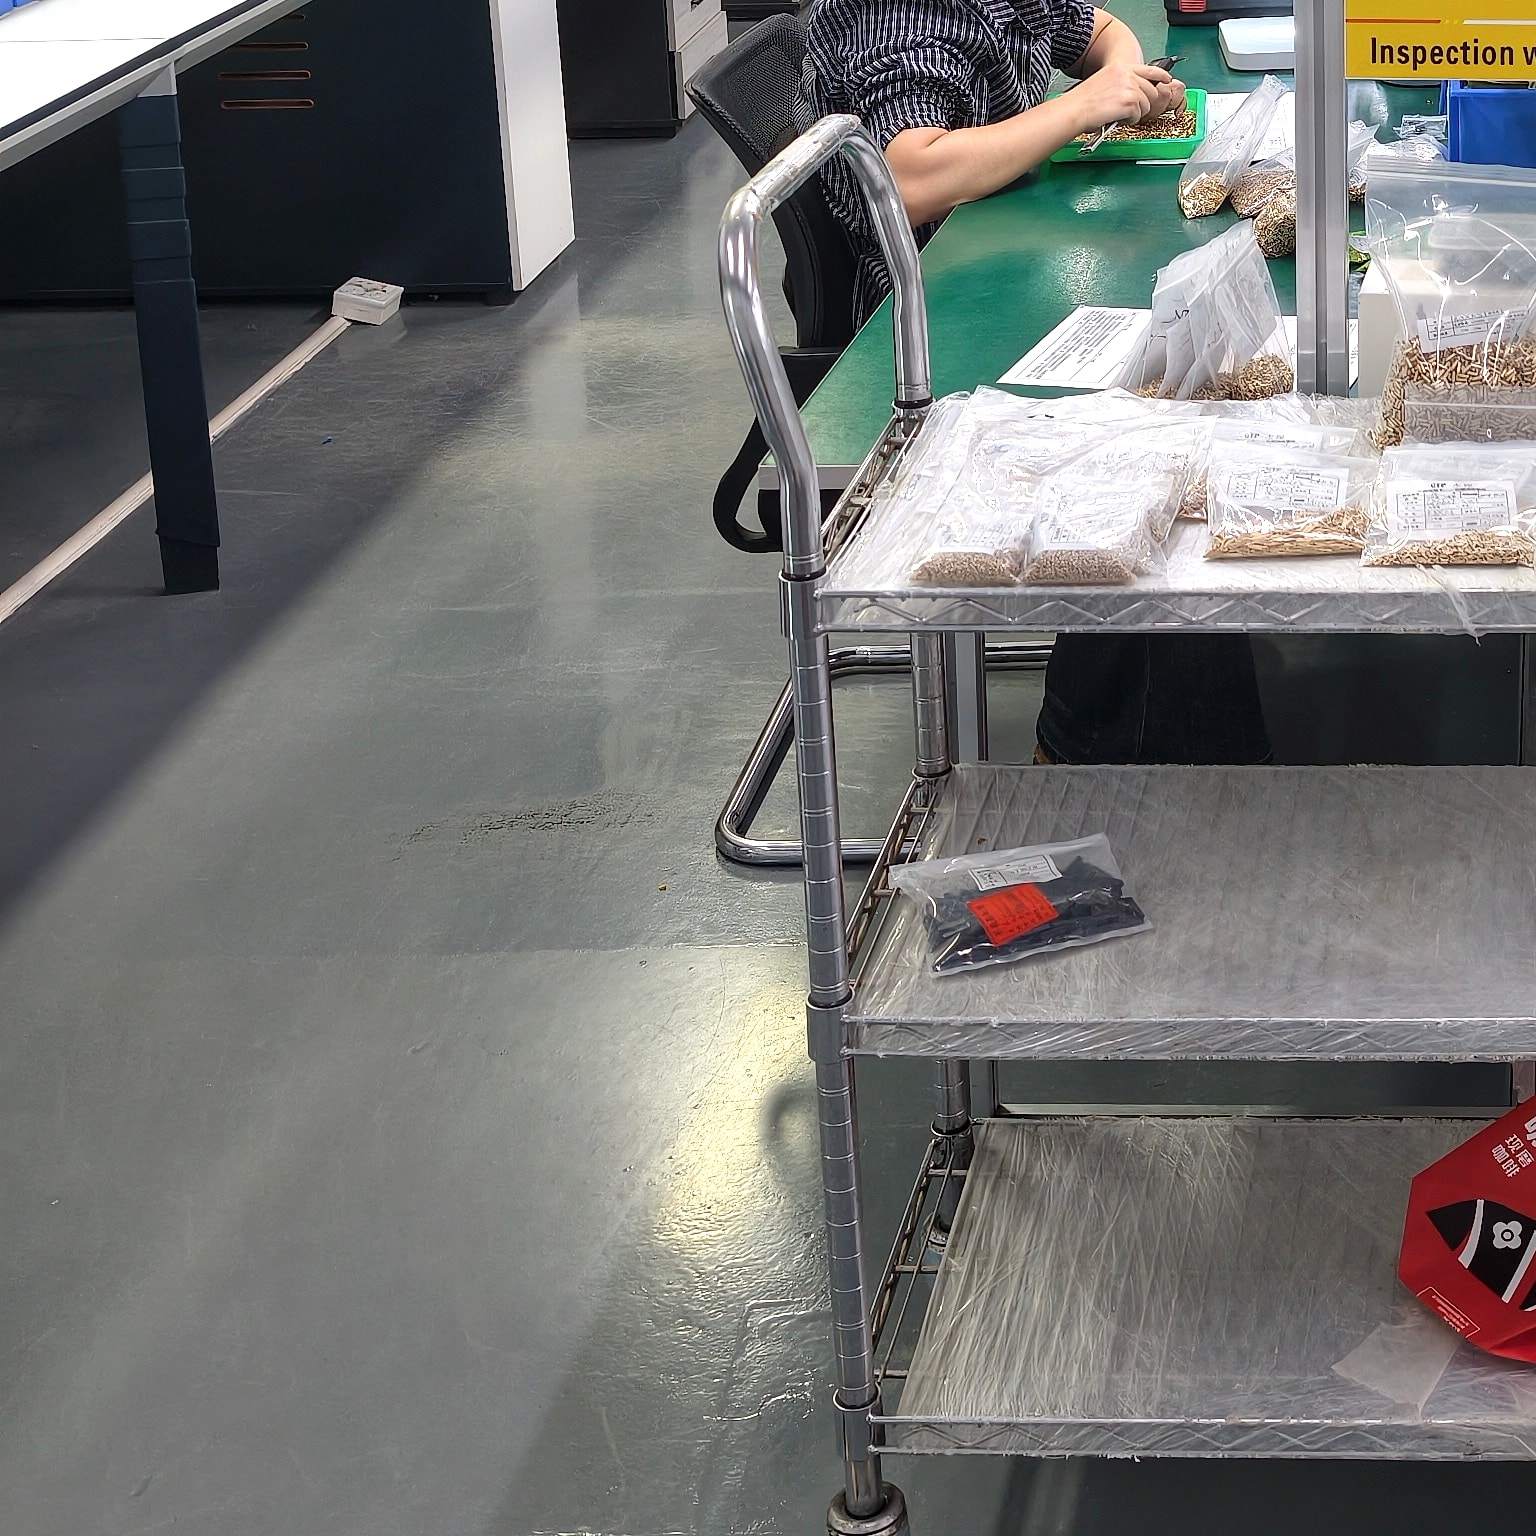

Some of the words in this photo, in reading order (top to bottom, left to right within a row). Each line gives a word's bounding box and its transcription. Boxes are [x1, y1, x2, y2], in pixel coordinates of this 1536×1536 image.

[1371, 38, 1513, 70] Inspection
[1491, 1144, 1521, 1178] 咖啡
[1504, 1133, 1535, 1168] 现磨
